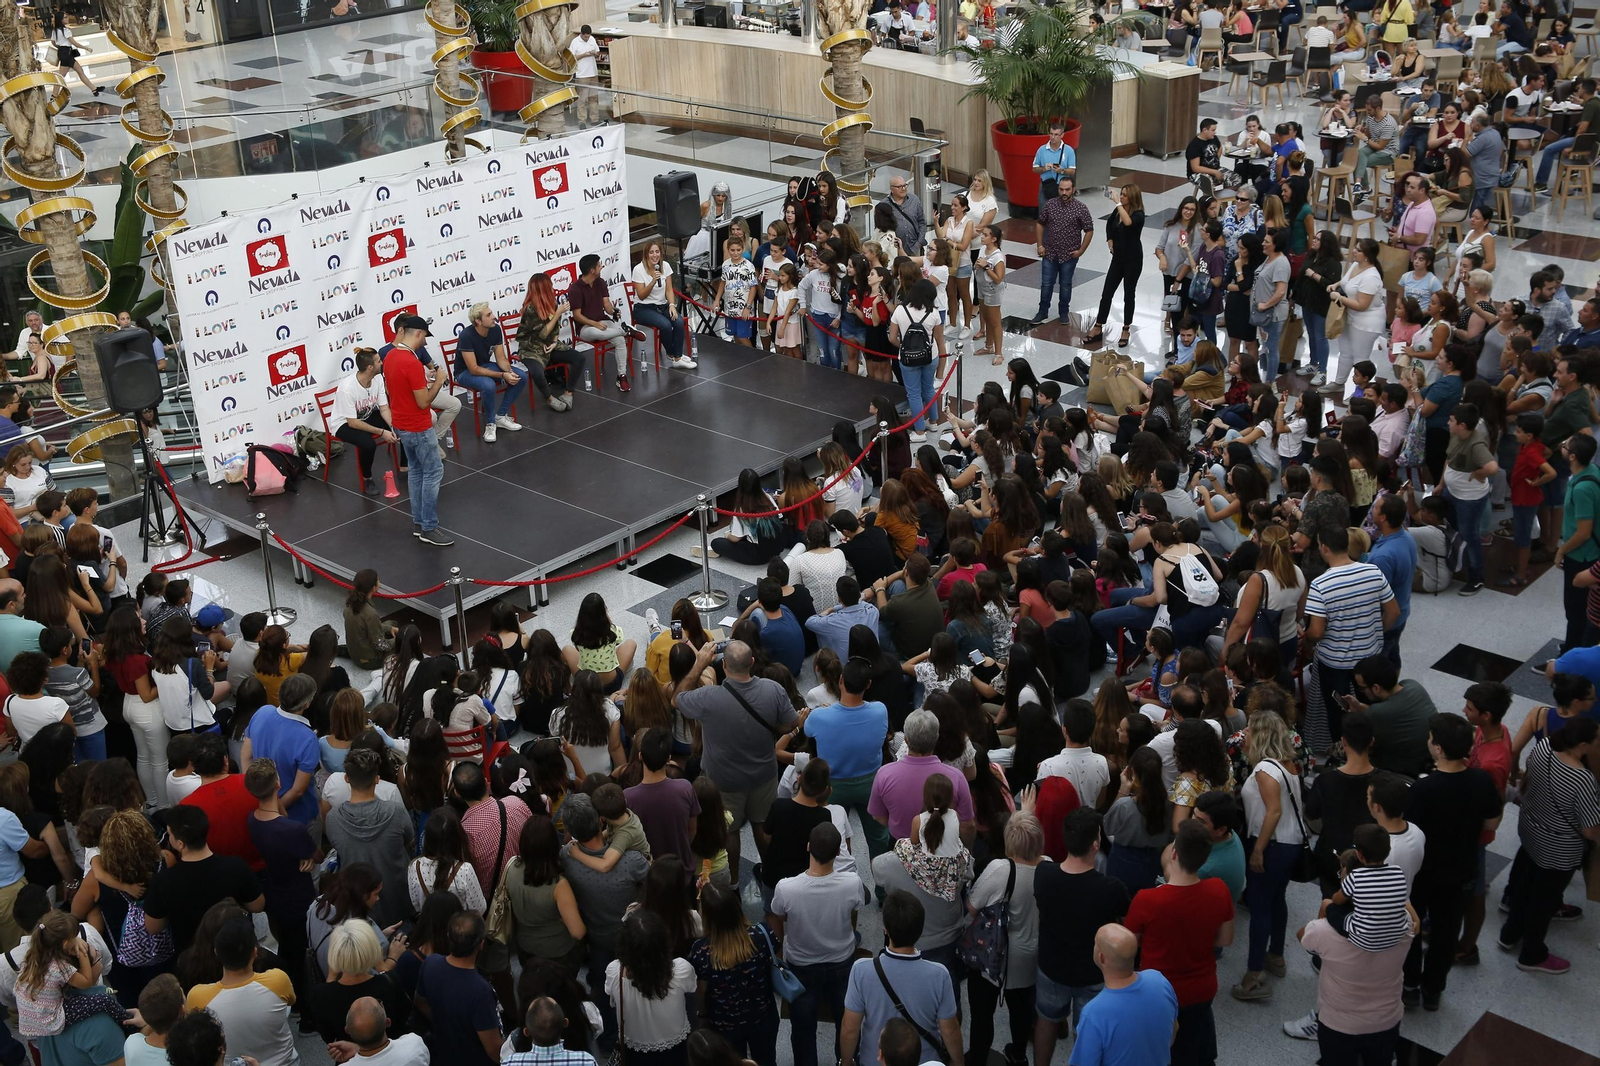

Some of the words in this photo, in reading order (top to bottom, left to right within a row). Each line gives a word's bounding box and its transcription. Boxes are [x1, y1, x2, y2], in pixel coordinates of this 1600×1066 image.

[592, 162, 616, 176] LOVE
[488, 187, 515, 202] LOVE
[433, 201, 460, 216] LOVE
[598, 208, 618, 223] LOVE
[376, 215, 405, 230] LOVE
[547, 222, 572, 236] LOVE
[320, 230, 349, 247] LOVE
[494, 236, 520, 251] LOVE
[440, 250, 466, 266] LOVE
[195, 264, 226, 282] LOVE
[383, 265, 411, 281] LOVE
[328, 282, 357, 299] LOVE
[499, 284, 525, 298] LOVE
[267, 300, 298, 317] LOVE
[447, 299, 472, 314] LOVE
[204, 319, 236, 336] LOVE
[336, 332, 363, 349] LOVE
[212, 372, 246, 389] LOVE
[284, 402, 314, 420] LOVE
[222, 422, 253, 441] LOVE
